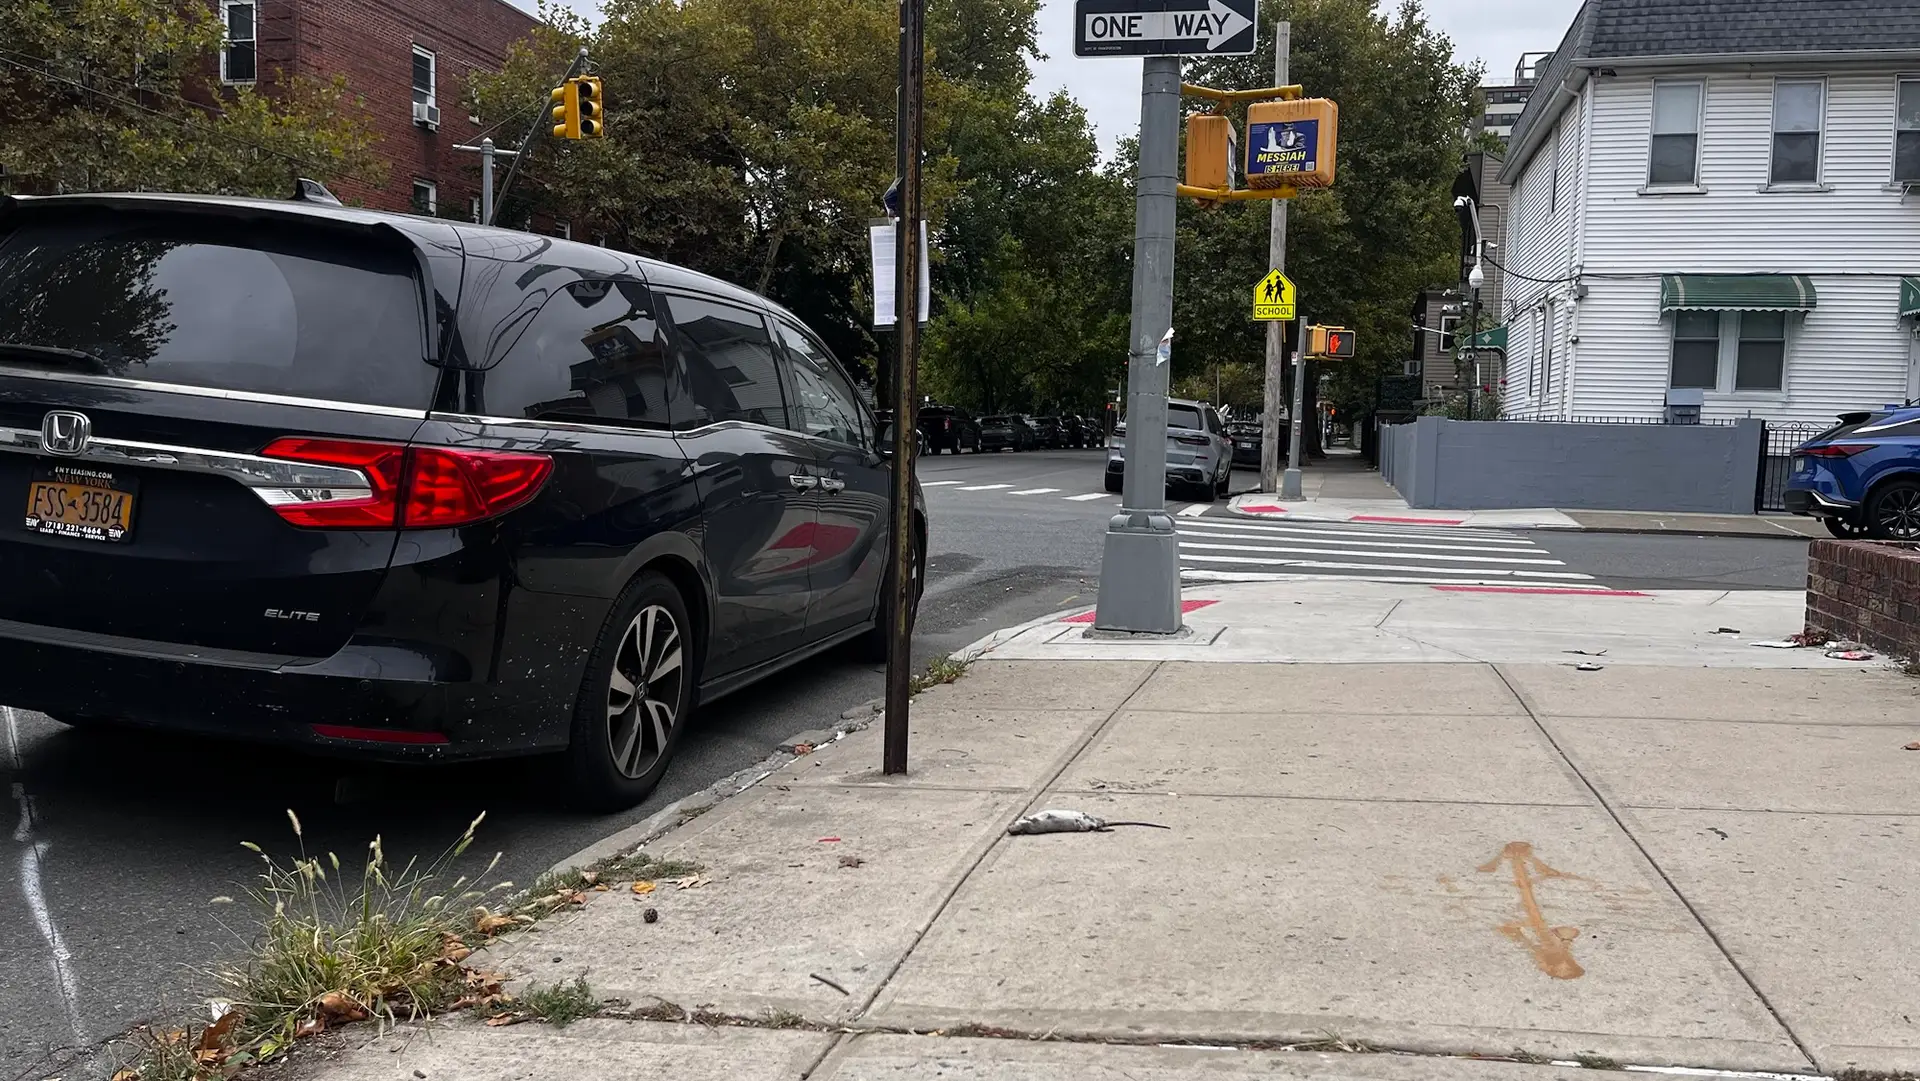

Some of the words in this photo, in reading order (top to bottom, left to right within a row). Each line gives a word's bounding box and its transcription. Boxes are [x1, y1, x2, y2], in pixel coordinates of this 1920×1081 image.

[1091, 15, 1143, 39] ONE
[1174, 13, 1231, 37] WAY
[1256, 151, 1307, 163] MESSIAH
[1256, 307, 1291, 316] SCHOOL
[71, 467, 113, 480] LEASING.COM
[56, 473, 82, 484] NEW
[85, 477, 112, 489] YORK
[79, 490, 123, 524] 3584
[45, 521, 64, 530] (718)
[66, 524, 102, 535] 221-4664
[84, 533, 106, 541] SERVICE
[264, 608, 321, 622] ELITE
